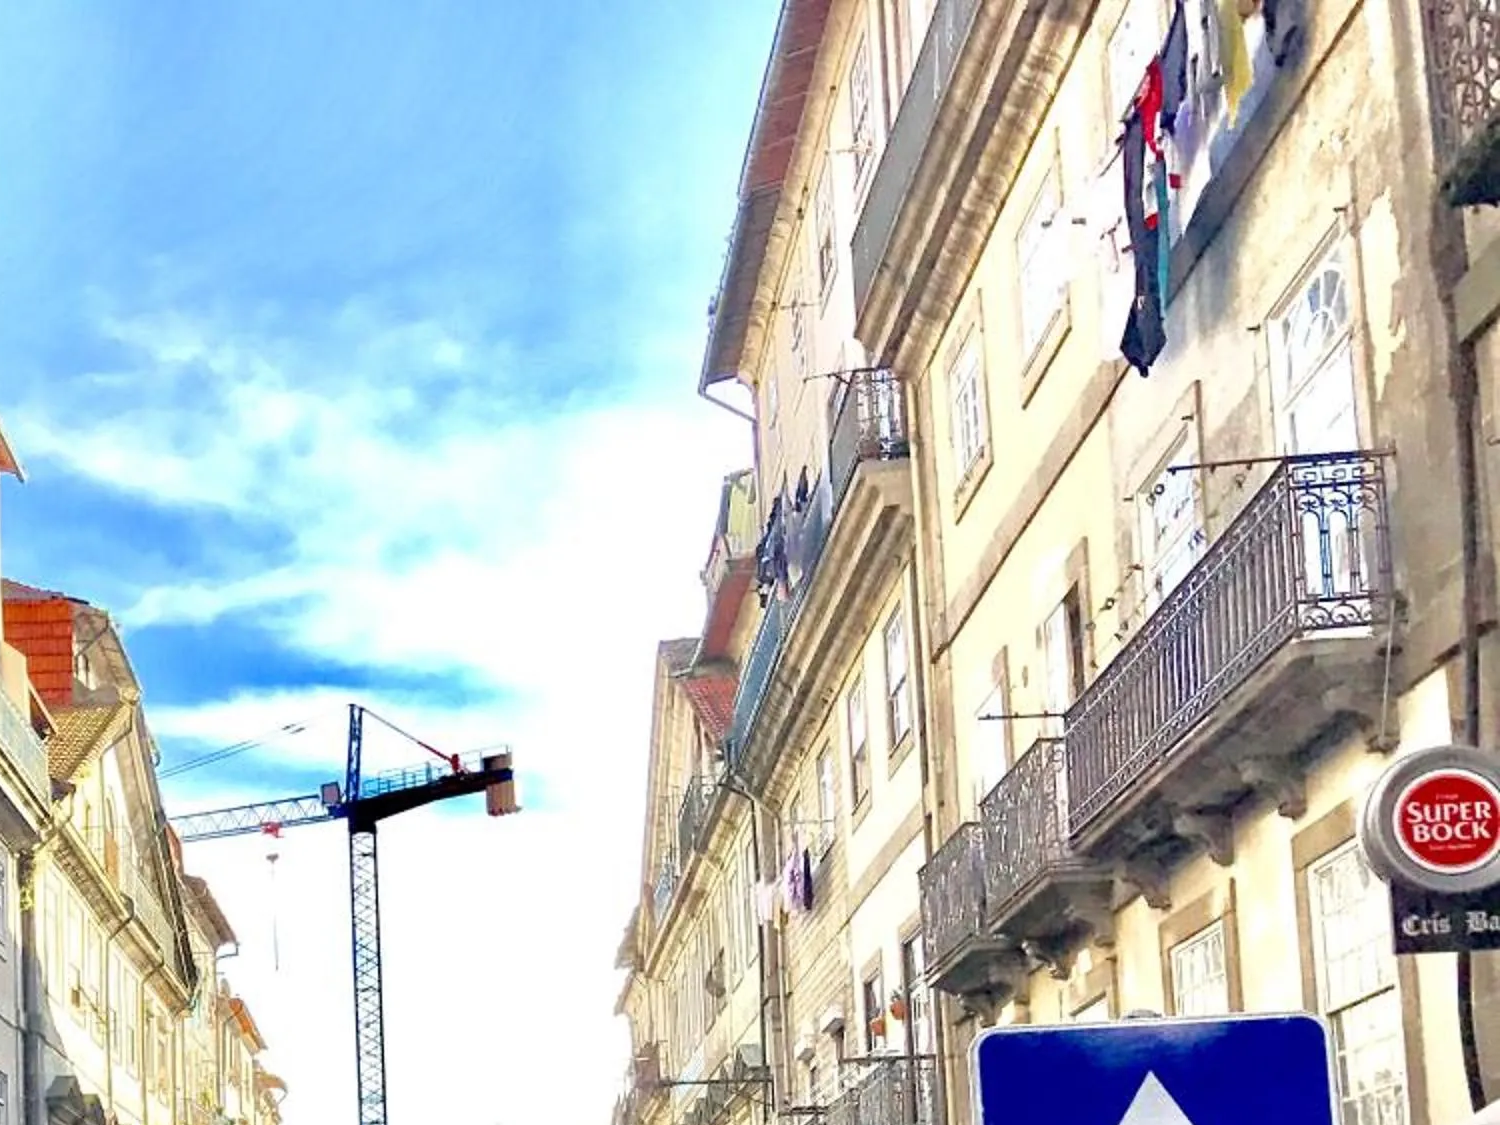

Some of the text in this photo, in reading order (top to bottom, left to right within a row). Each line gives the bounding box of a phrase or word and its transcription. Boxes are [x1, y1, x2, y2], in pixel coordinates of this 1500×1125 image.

[1406, 801, 1492, 824] SUPER
[1412, 820, 1491, 843] BOCK
[1402, 912, 1452, 936] Cris
